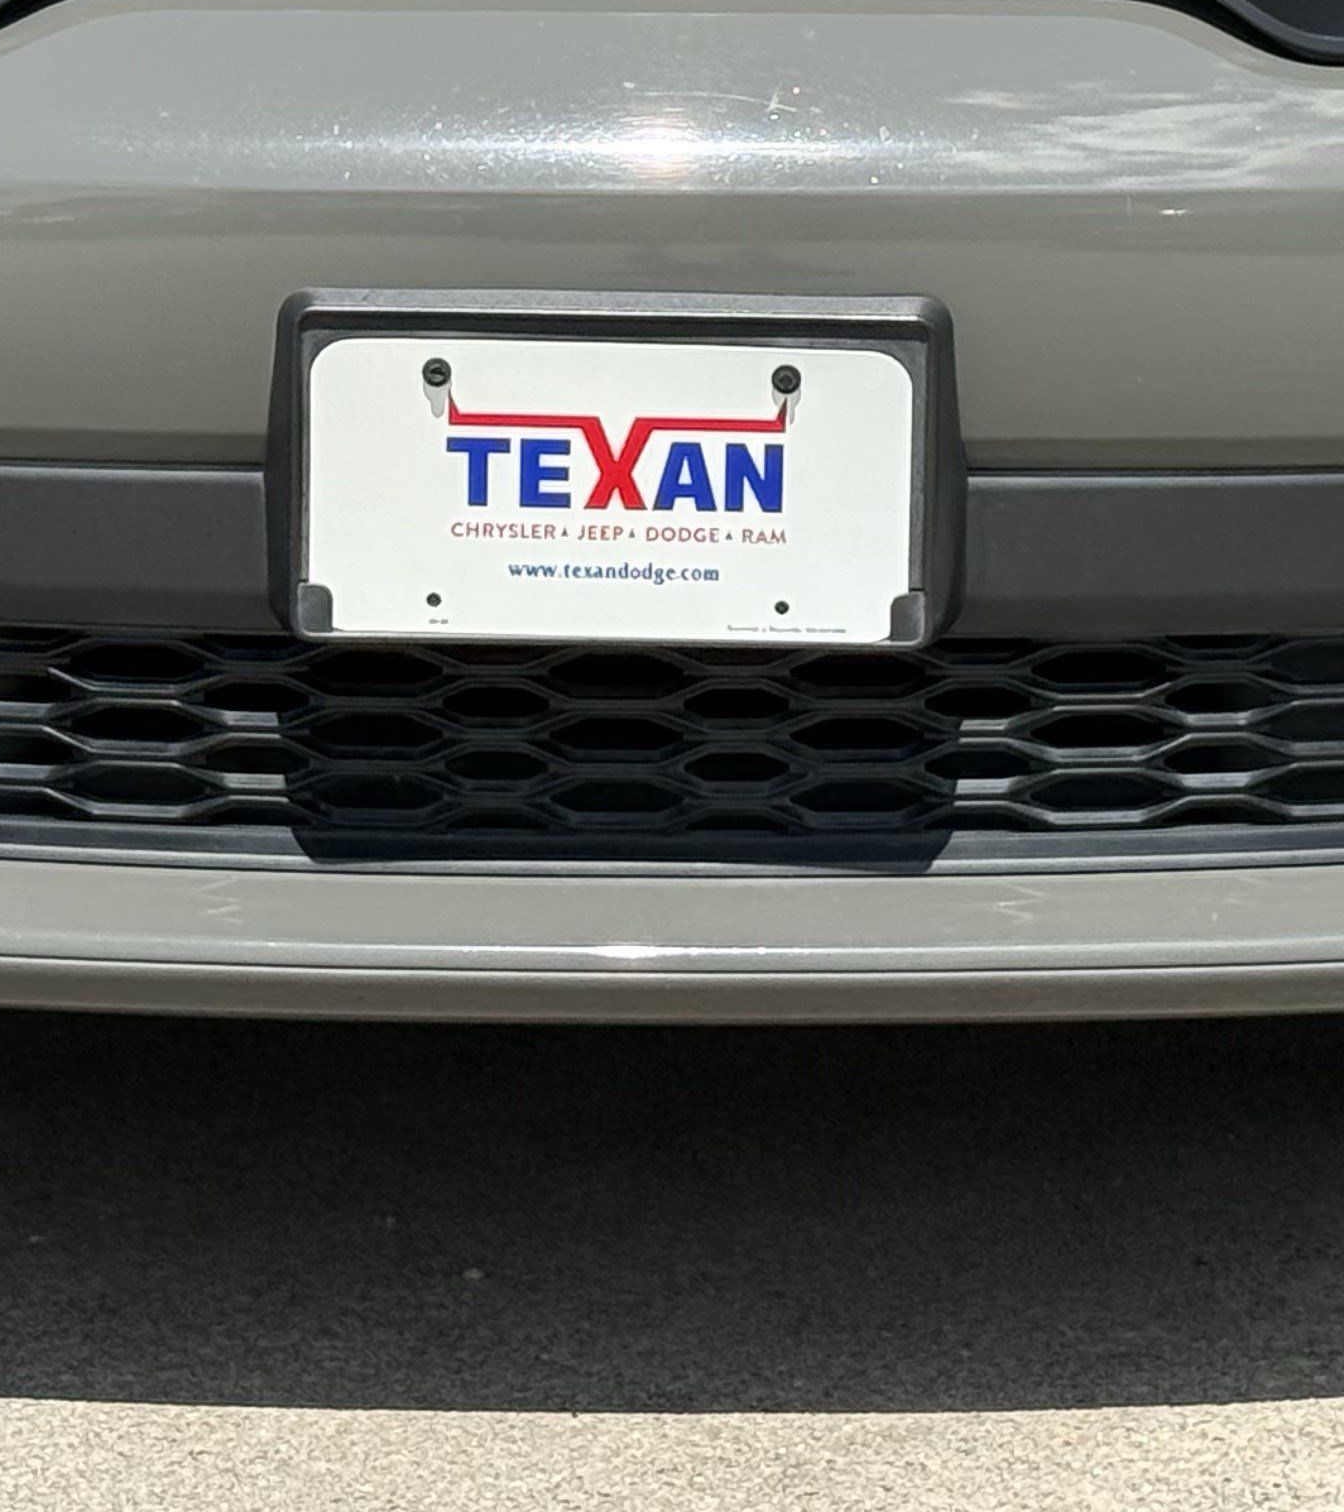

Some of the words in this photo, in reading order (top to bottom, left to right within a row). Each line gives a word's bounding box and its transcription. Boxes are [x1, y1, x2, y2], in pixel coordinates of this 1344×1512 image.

[446, 415, 786, 513] TEXAN
[450, 521, 557, 540] CHRYSLER
[577, 524, 624, 541] JEEP
[645, 526, 721, 544] DODGE
[741, 528, 788, 545] RAM
[508, 562, 720, 586] www.texandodge.com
